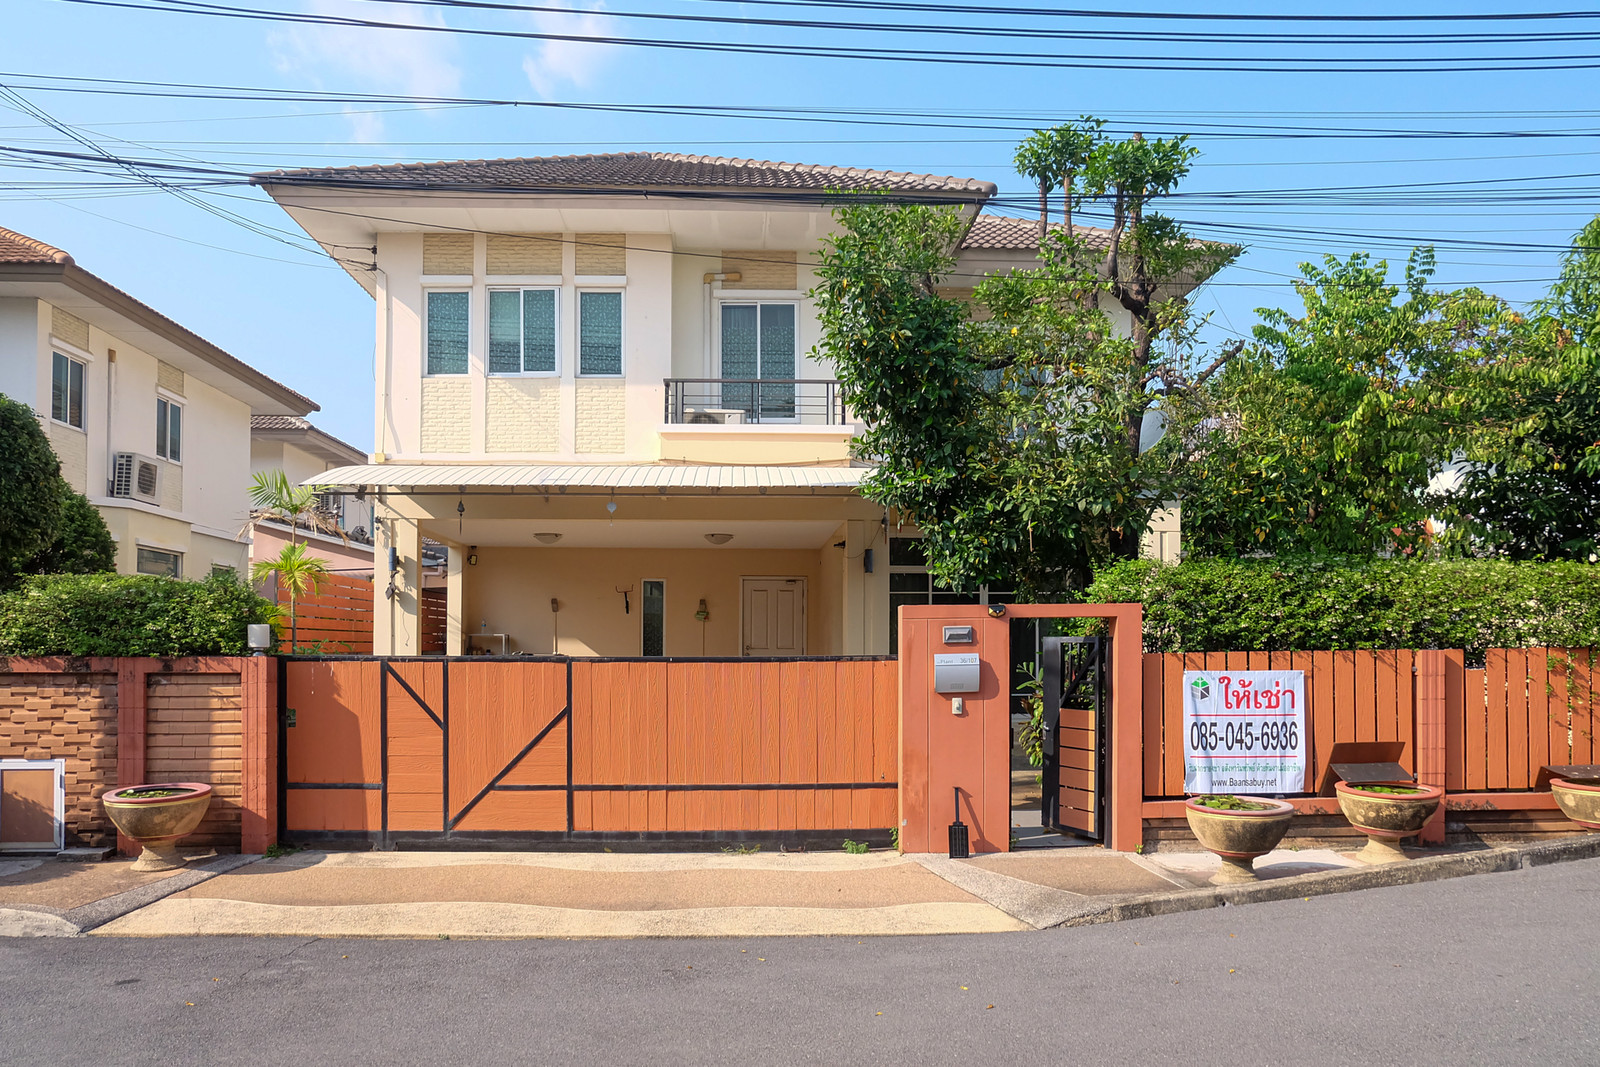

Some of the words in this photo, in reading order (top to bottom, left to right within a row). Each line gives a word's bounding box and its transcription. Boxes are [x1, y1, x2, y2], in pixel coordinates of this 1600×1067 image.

[1218, 676, 1295, 709] ให้เช่า
[1190, 721, 1298, 751] 085-045-6936
[1211, 777, 1277, 788] www.Baansabuy.net
